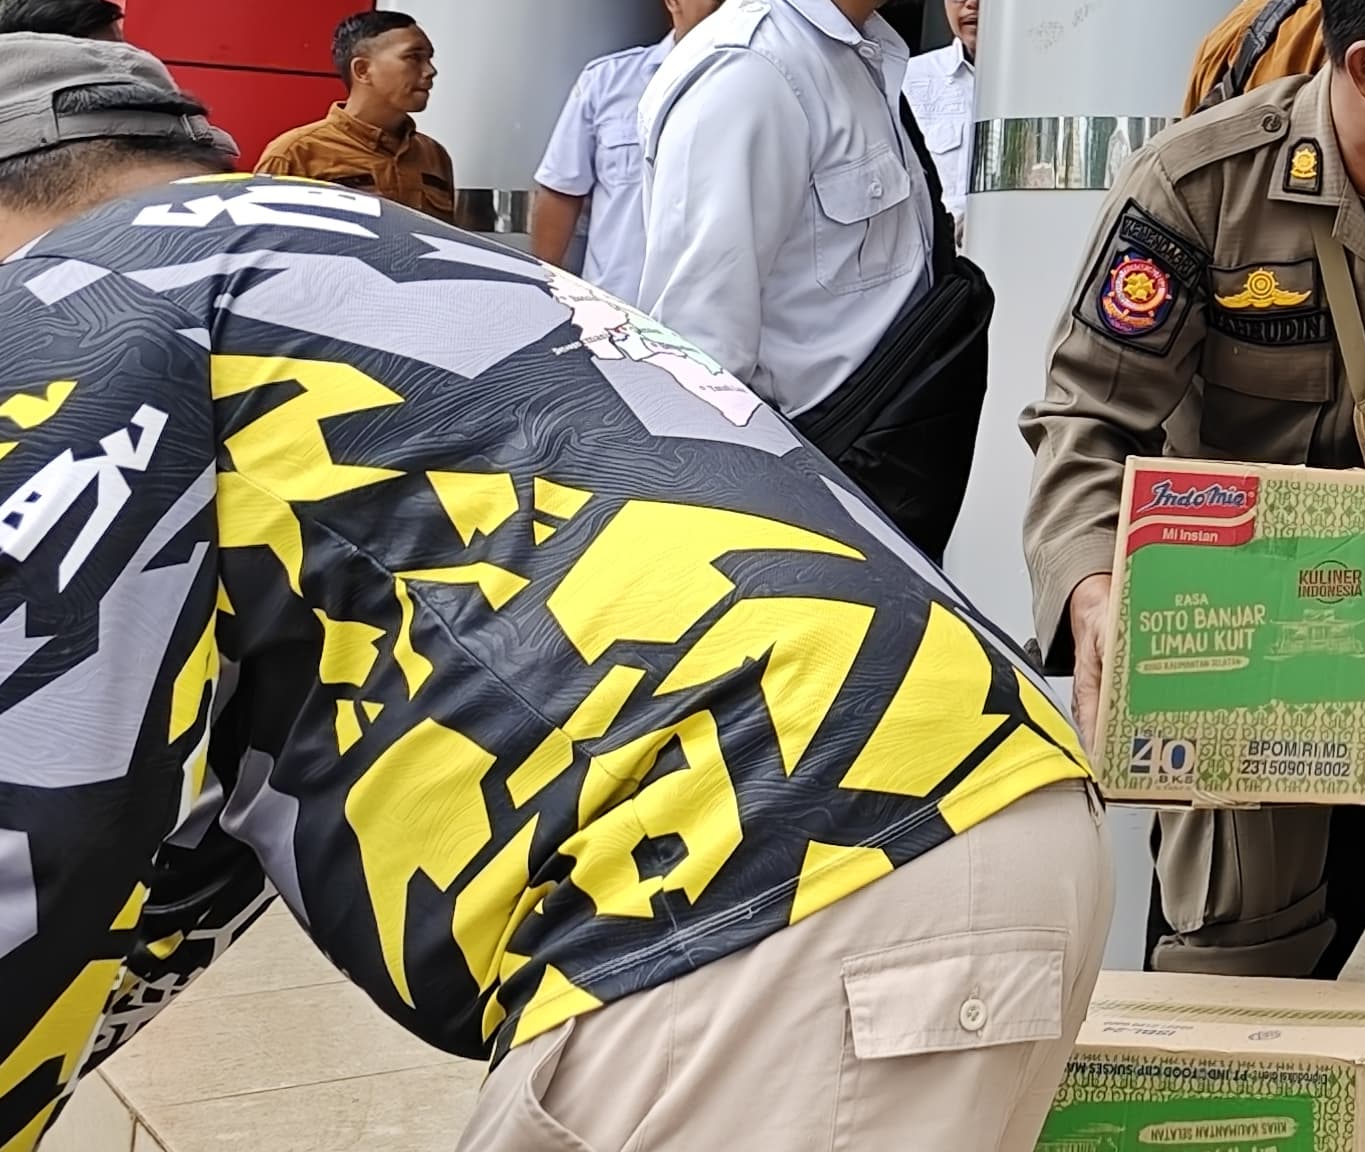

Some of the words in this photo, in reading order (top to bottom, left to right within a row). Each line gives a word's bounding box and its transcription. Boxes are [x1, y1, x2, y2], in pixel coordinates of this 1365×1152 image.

[1299, 569, 1362, 585] KULINER
[1298, 584, 1363, 598] INDONESIA
[1176, 594, 1208, 607] RASA
[1140, 610, 1188, 633] SOTO
[1194, 604, 1266, 628] BANJAR
[1152, 633, 1208, 655] LIMAU
[1215, 628, 1255, 650] KUIT
[1130, 737, 1197, 774] 40
[1249, 741, 1297, 758] BPOM
[1302, 742, 1318, 759] RI
[1323, 743, 1348, 759] MD
[1241, 760, 1350, 776] 231509018002
[1089, 1064, 1133, 1076] SUKSES
